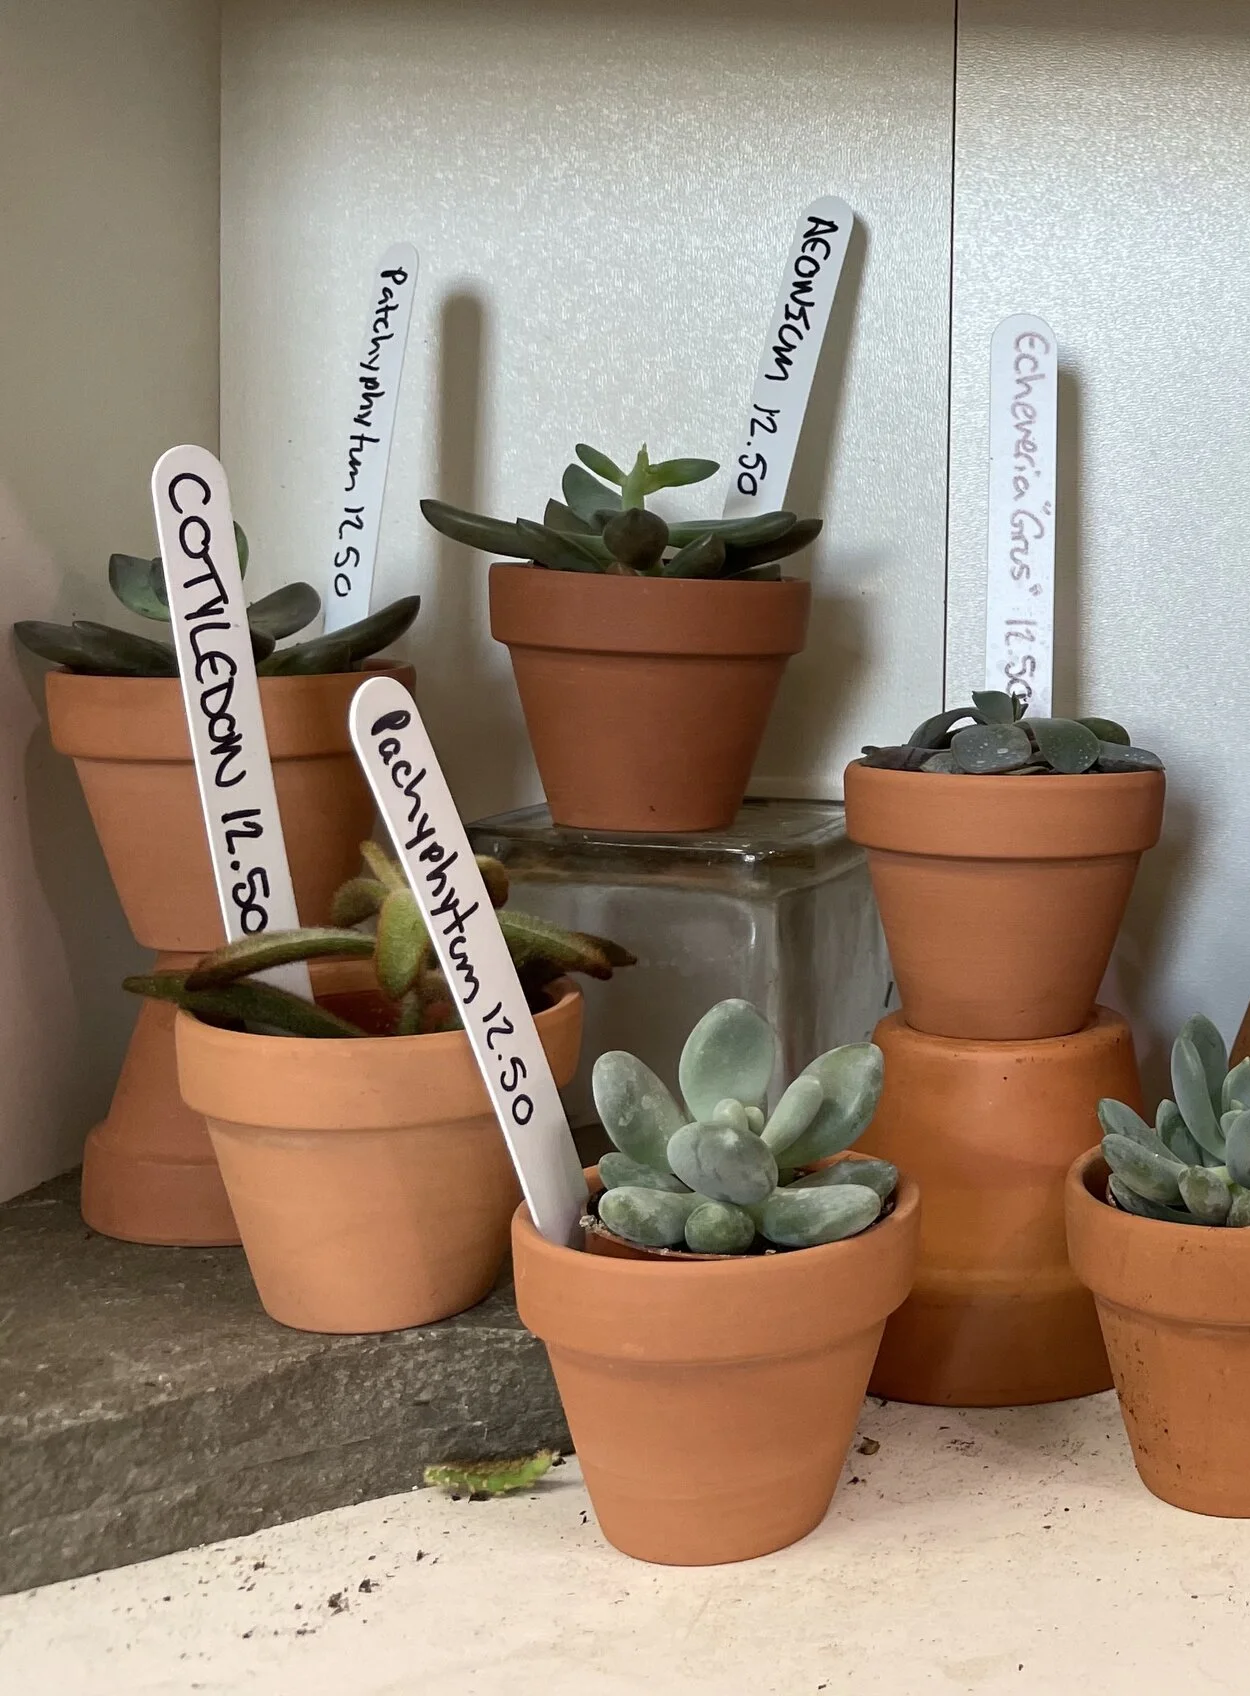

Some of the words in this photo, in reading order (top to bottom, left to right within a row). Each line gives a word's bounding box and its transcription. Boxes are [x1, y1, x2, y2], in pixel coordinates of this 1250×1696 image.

[737, 403, 781, 497] 12.50
[168, 472, 247, 788] COTYLEDON
[221, 808, 270, 936] 12.50
[1005, 618, 1037, 700] 12.50
[371, 709, 480, 1005] Pachyphytum
[482, 1001, 535, 1127] 12.50
